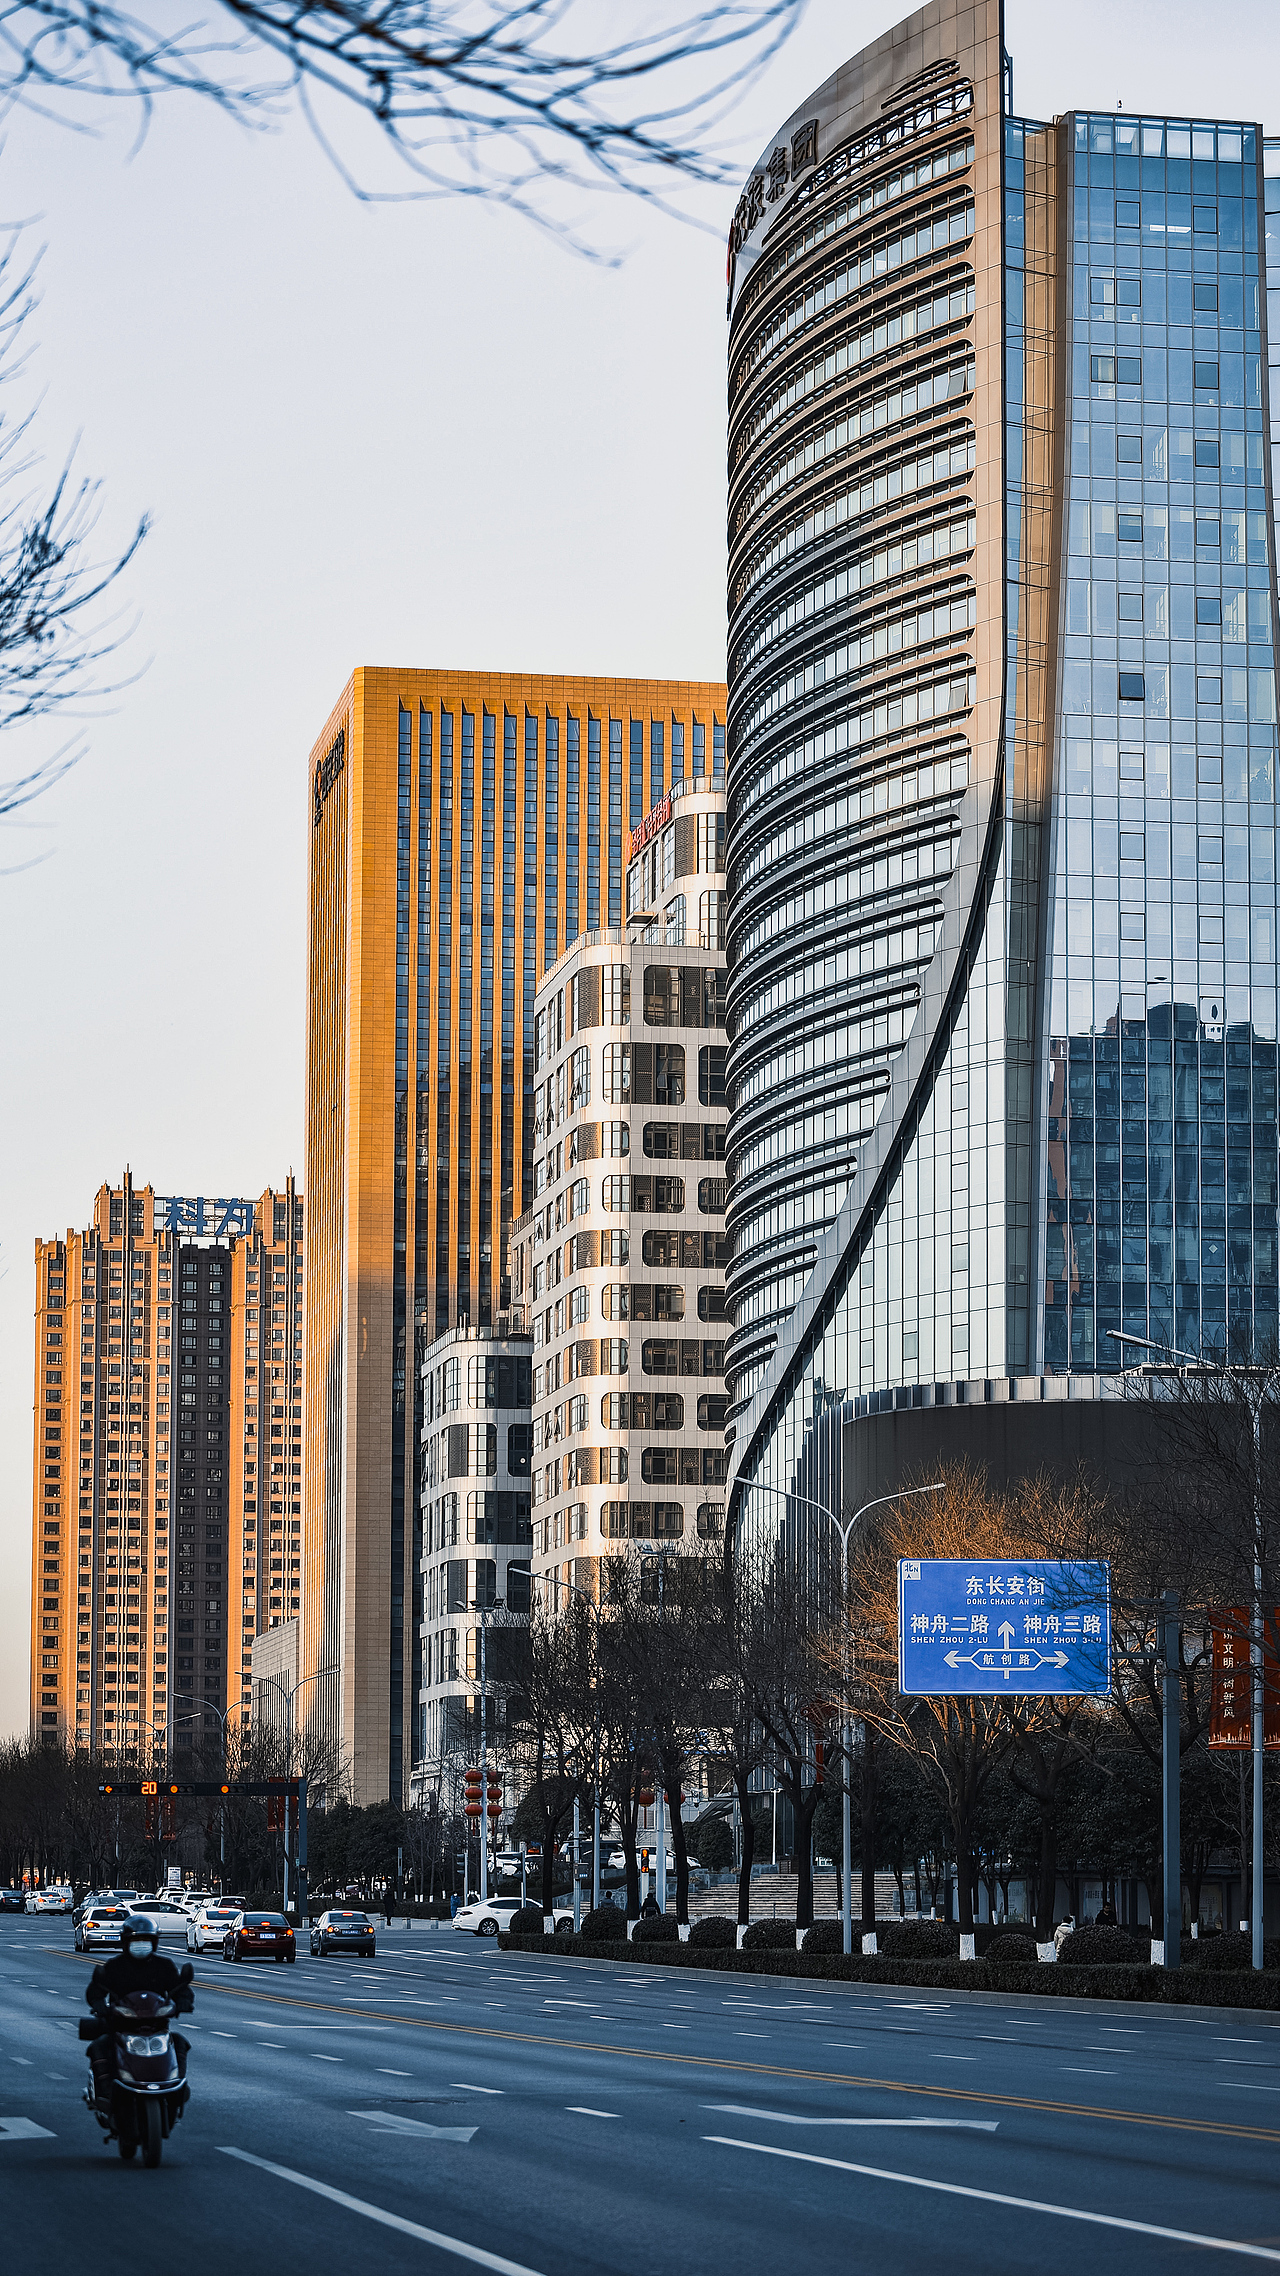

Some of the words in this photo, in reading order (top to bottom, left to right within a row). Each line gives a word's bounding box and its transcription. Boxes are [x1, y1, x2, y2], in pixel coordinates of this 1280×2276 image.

[164, 1197, 254, 1236] 科为
[966, 1576, 1045, 1595] 东长安街
[910, 1614, 989, 1634] 神舟二路
[1023, 1614, 1101, 1634] 神舟三路
[983, 1653, 1030, 1665] 航创路
[141, 1781, 157, 1794] 20
